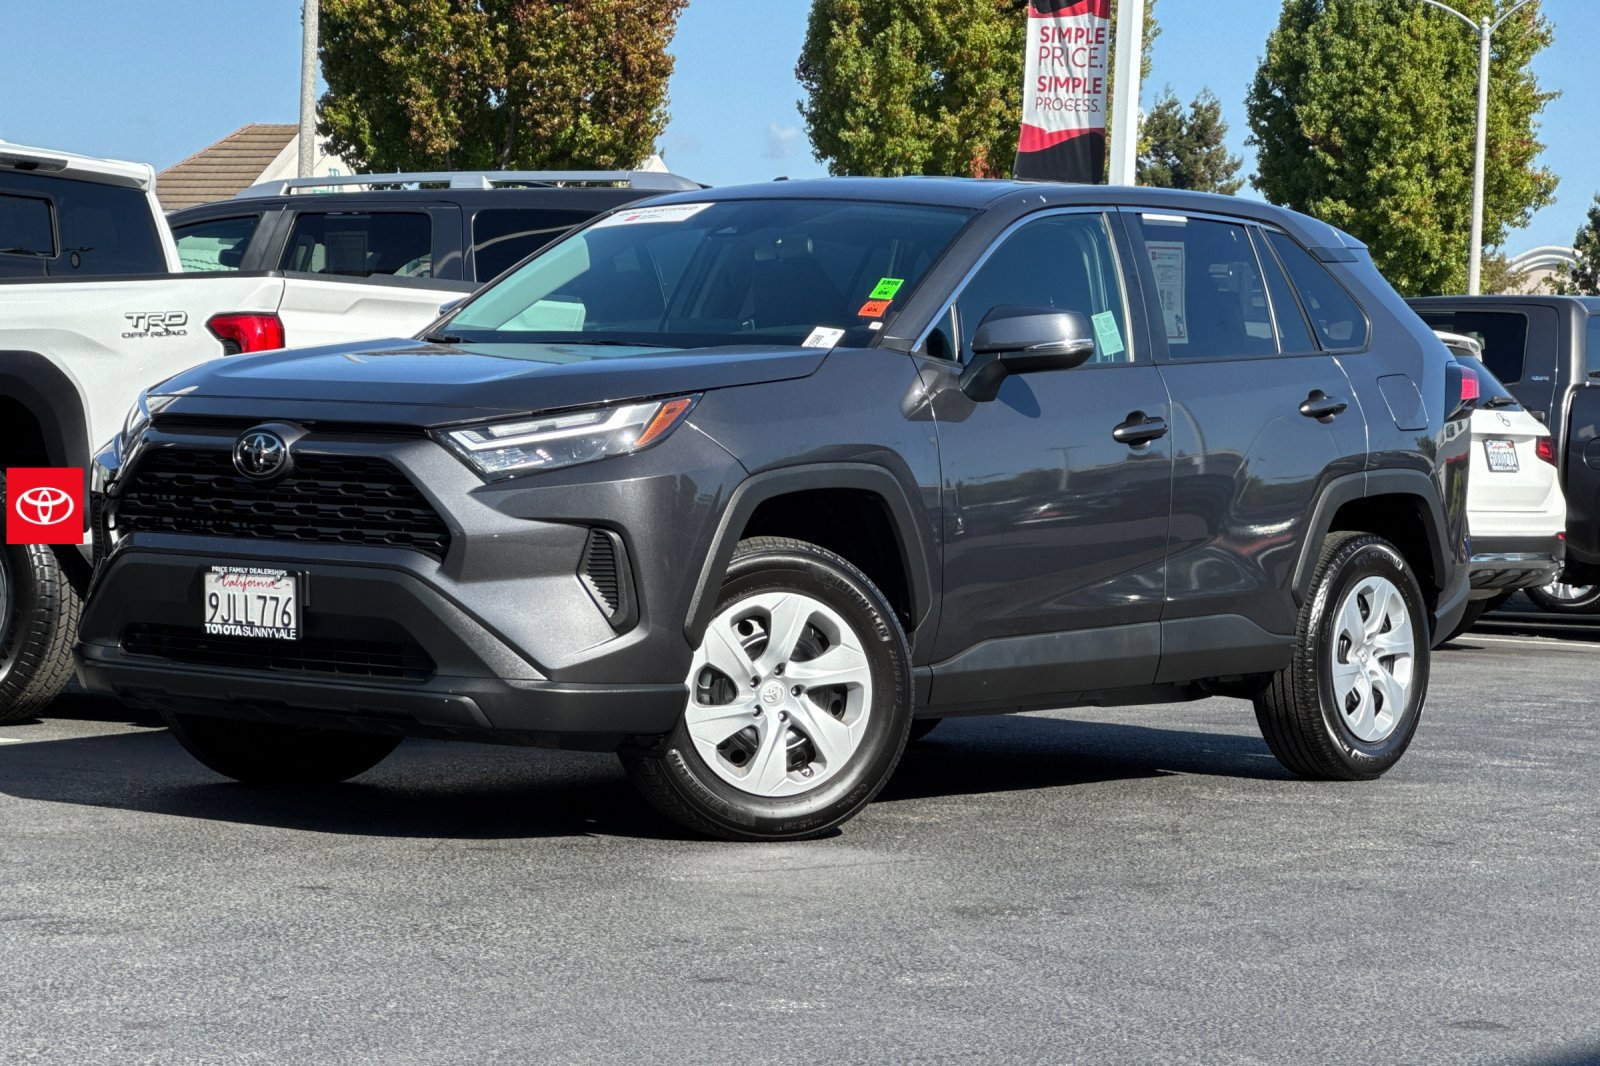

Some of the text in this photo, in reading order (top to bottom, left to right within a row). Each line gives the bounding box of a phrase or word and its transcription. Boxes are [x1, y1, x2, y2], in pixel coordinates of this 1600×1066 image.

[1040, 26, 1105, 44] SIMPLE
[1038, 46, 1103, 68] PRICE.
[1037, 76, 1103, 94] SIMPLE
[1035, 97, 1100, 113] PROCESS.
[125, 311, 188, 332] TRD
[150, 329, 188, 338] ROAD
[229, 566, 249, 574] FAMILY
[249, 568, 287, 577] DEALERSHIPS
[222, 574, 281, 592] California
[209, 592, 292, 627] 9JLL776
